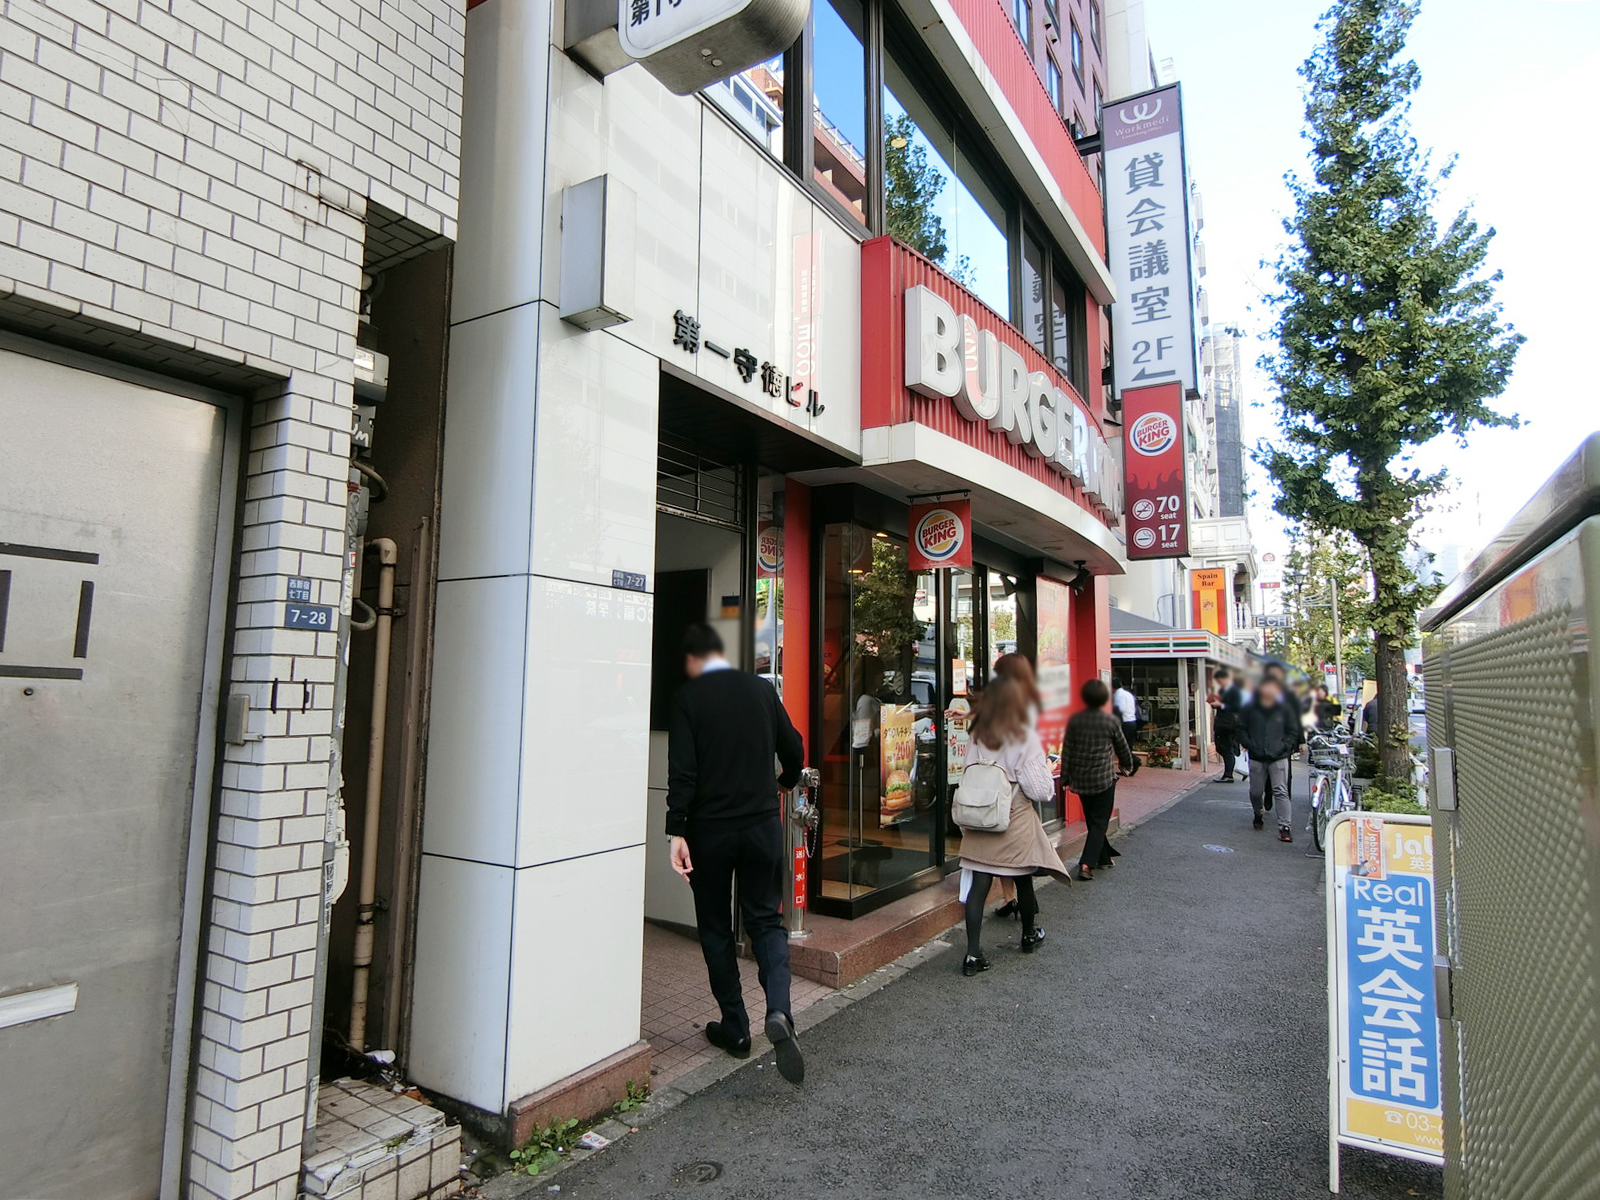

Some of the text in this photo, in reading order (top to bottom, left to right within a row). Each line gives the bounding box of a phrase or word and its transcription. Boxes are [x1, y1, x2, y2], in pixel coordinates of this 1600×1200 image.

[1114, 115, 1170, 136] Workmedi
[1124, 152, 1171, 325] 貸会議室
[1131, 335, 1174, 364] 2F
[673, 309, 825, 417] 第一守徳ビル
[905, 285, 1090, 488] BURGER
[1136, 419, 1168, 438] BURGER
[1138, 426, 1170, 447] KING
[1156, 495, 1180, 513] 70
[1160, 511, 1177, 519] seat
[922, 518, 955, 538] BURGER
[923, 526, 957, 549] KING
[1158, 524, 1181, 542] 17
[1161, 539, 1178, 548] seat
[289, 579, 311, 590] 西新宿
[626, 575, 644, 587] 7-27
[288, 590, 310, 600] 七丁目
[290, 609, 327, 625] 7-28
[1354, 878, 1424, 907] Real
[1357, 905, 1428, 1102] 英会話
